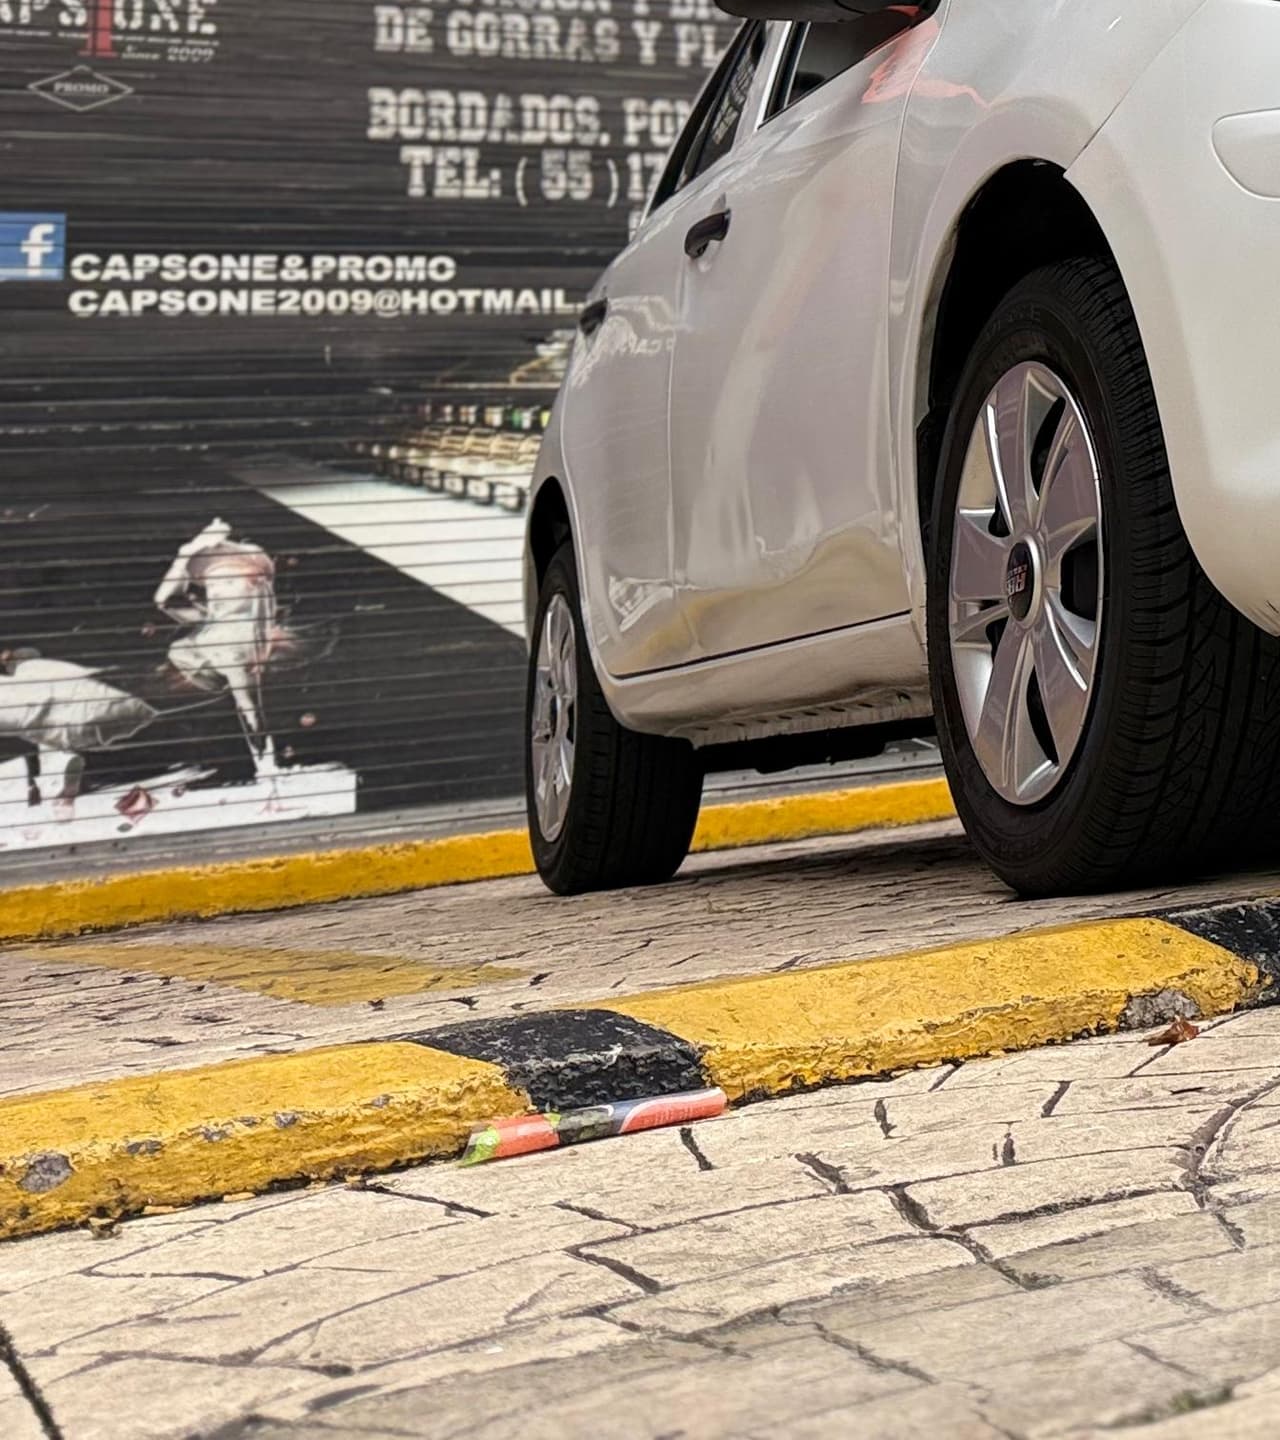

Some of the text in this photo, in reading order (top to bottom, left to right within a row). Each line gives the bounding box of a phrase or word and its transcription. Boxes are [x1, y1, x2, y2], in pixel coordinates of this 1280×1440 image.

[373, 5, 424, 52] DE
[445, 10, 620, 61] GORRAS
[631, 20, 663, 66] Y
[53, 81, 110, 97] PROMO
[400, 145, 502, 199] TEL:
[70, 253, 457, 283] CAPSONE&PROMO
